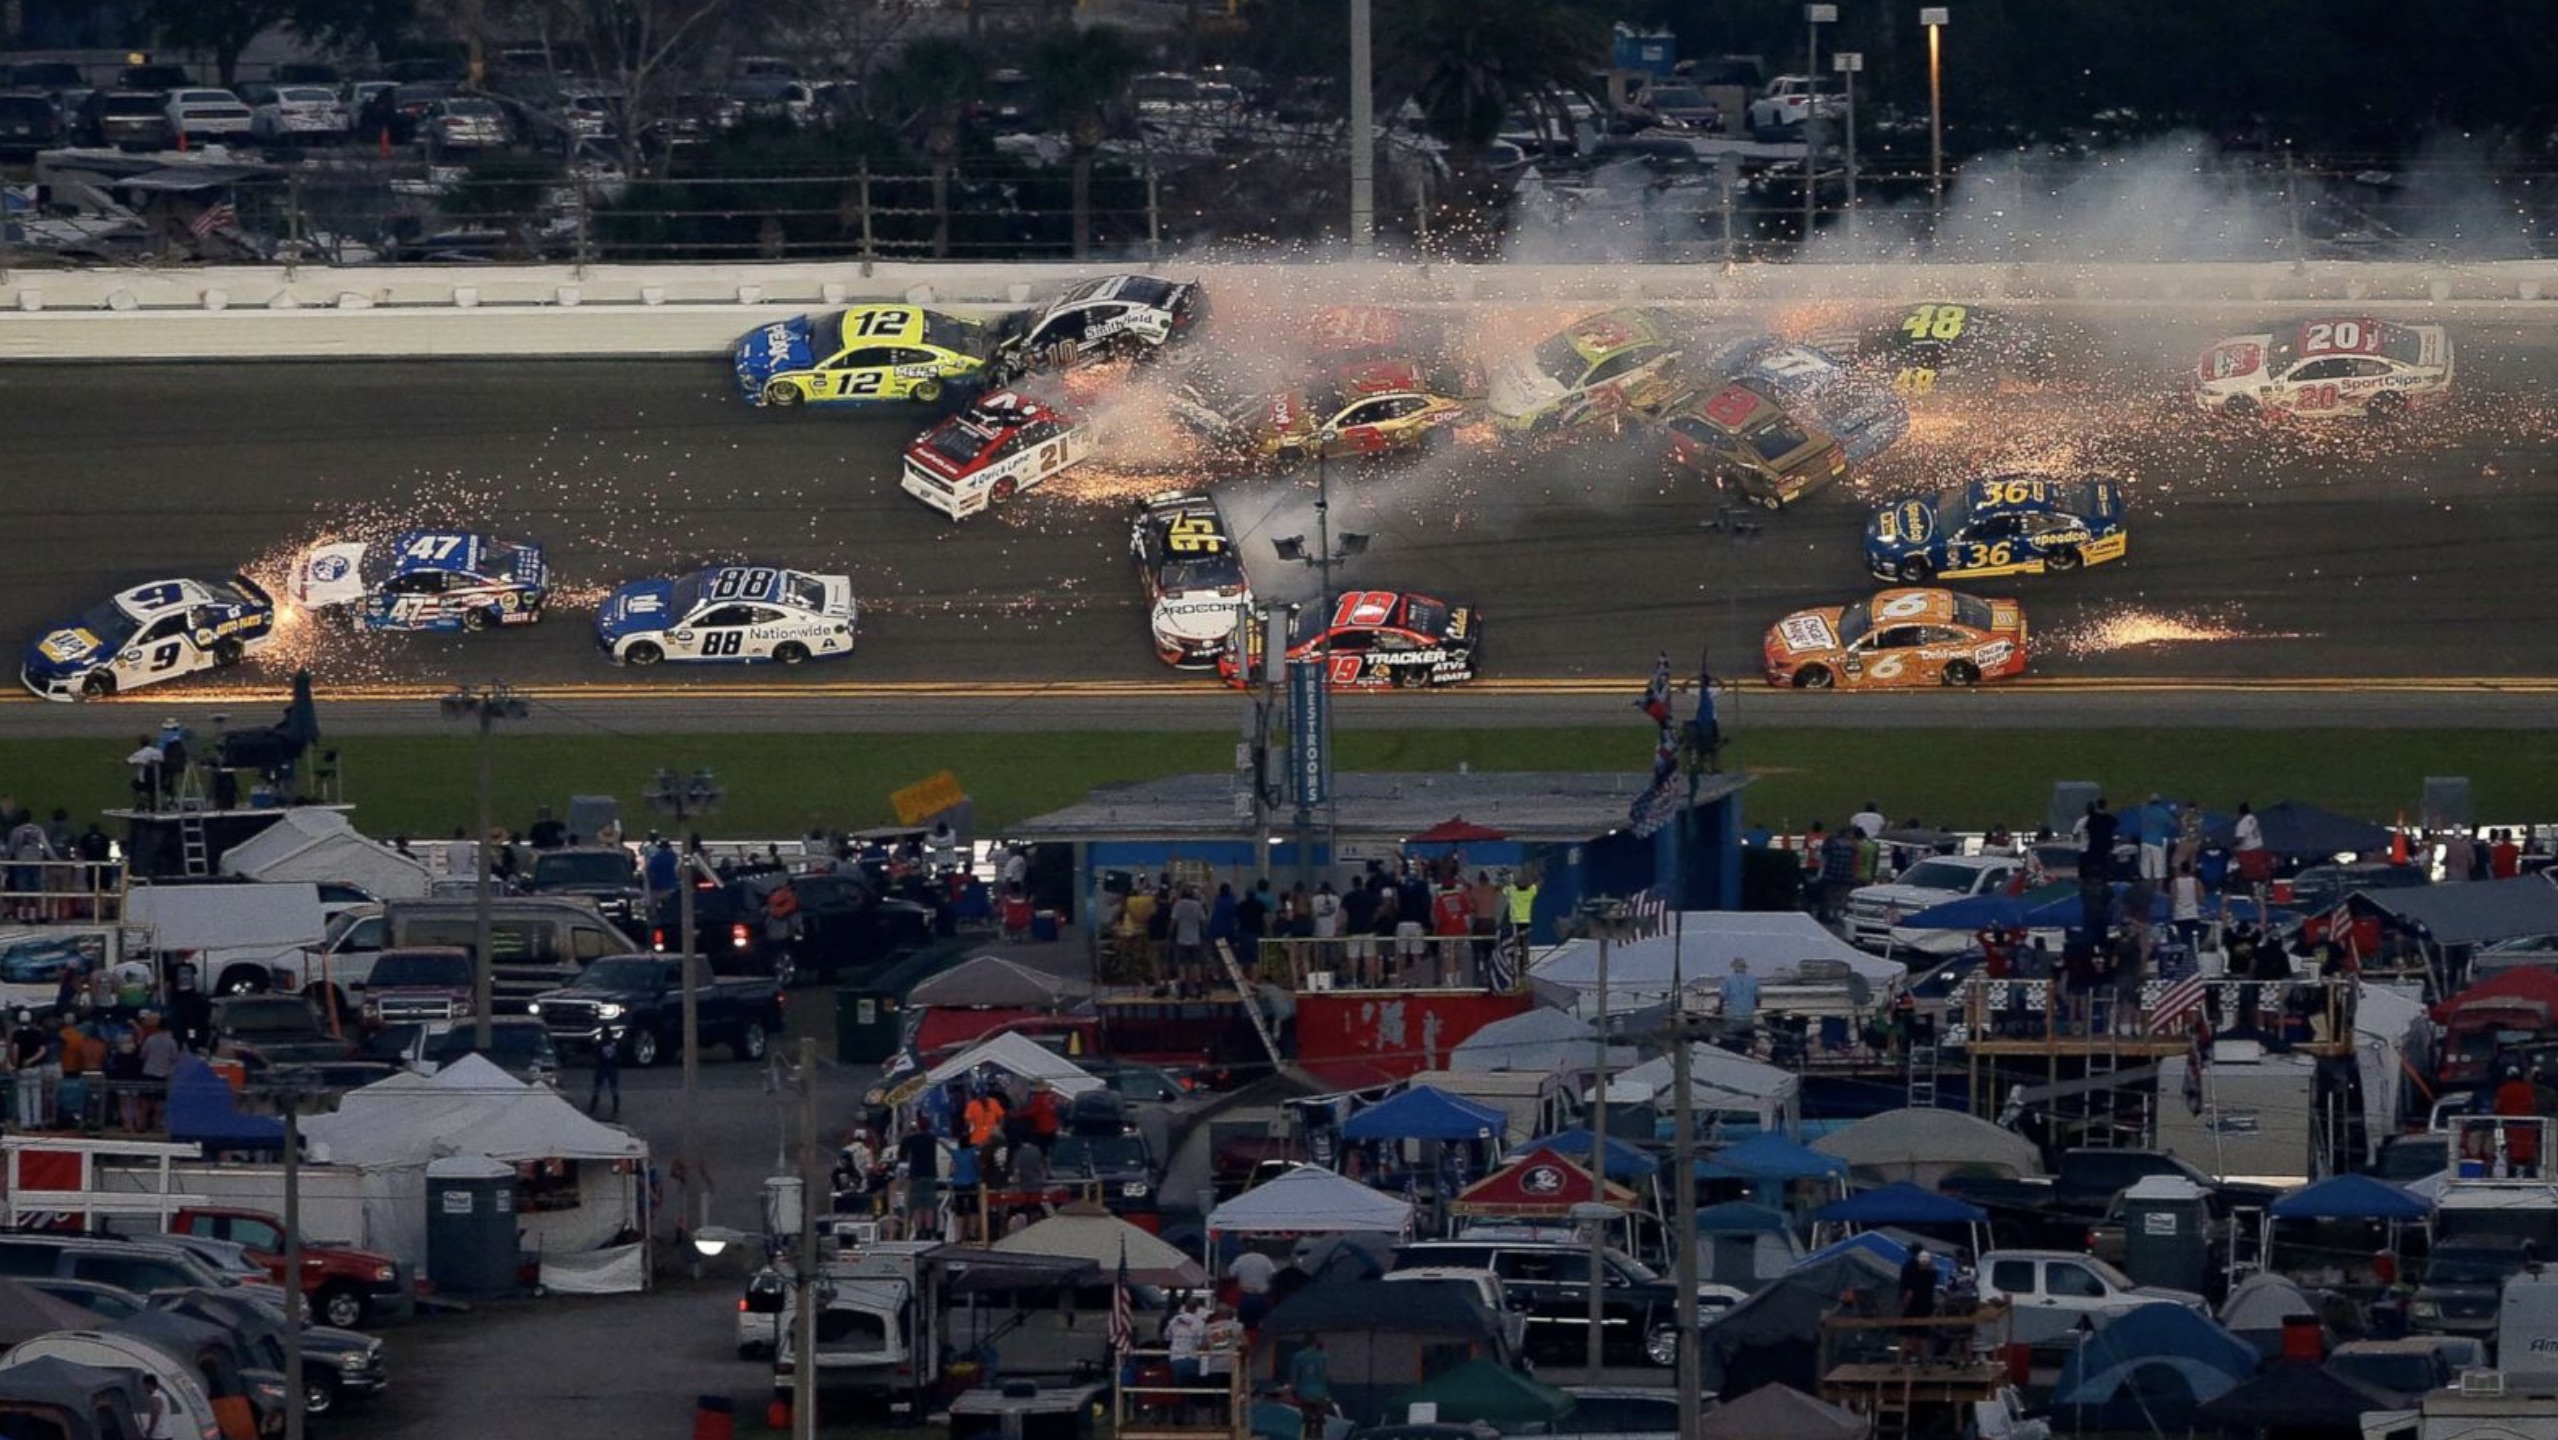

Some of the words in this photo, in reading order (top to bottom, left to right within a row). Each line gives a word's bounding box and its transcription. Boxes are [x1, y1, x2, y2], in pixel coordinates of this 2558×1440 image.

[854, 311, 910, 336] 12
[1902, 304, 1966, 340] 48
[763, 323, 790, 368] PEAK
[2308, 322, 2360, 351] 20
[1047, 338, 1078, 365] 10
[837, 372, 882, 395] 12
[2298, 383, 2338, 410] 20
[1040, 437, 1068, 472] 21
[1980, 480, 2030, 506] 36
[1169, 510, 1218, 552] 95
[407, 535, 462, 560] 47
[1967, 542, 2010, 569] 36
[711, 567, 777, 600] 88
[389, 597, 426, 620] 47
[1156, 602, 1242, 620] PROCOR
[1331, 592, 1398, 625] 19
[1882, 593, 1928, 617] 6
[700, 631, 743, 656] 88
[751, 626, 831, 641] Nationwide
[150, 642, 181, 672] 9
[1324, 655, 1362, 683] 19
[1365, 651, 1447, 665] TRACKER
[1870, 655, 1904, 679] 6
[1305, 680, 1318, 802] RESTROOMS
